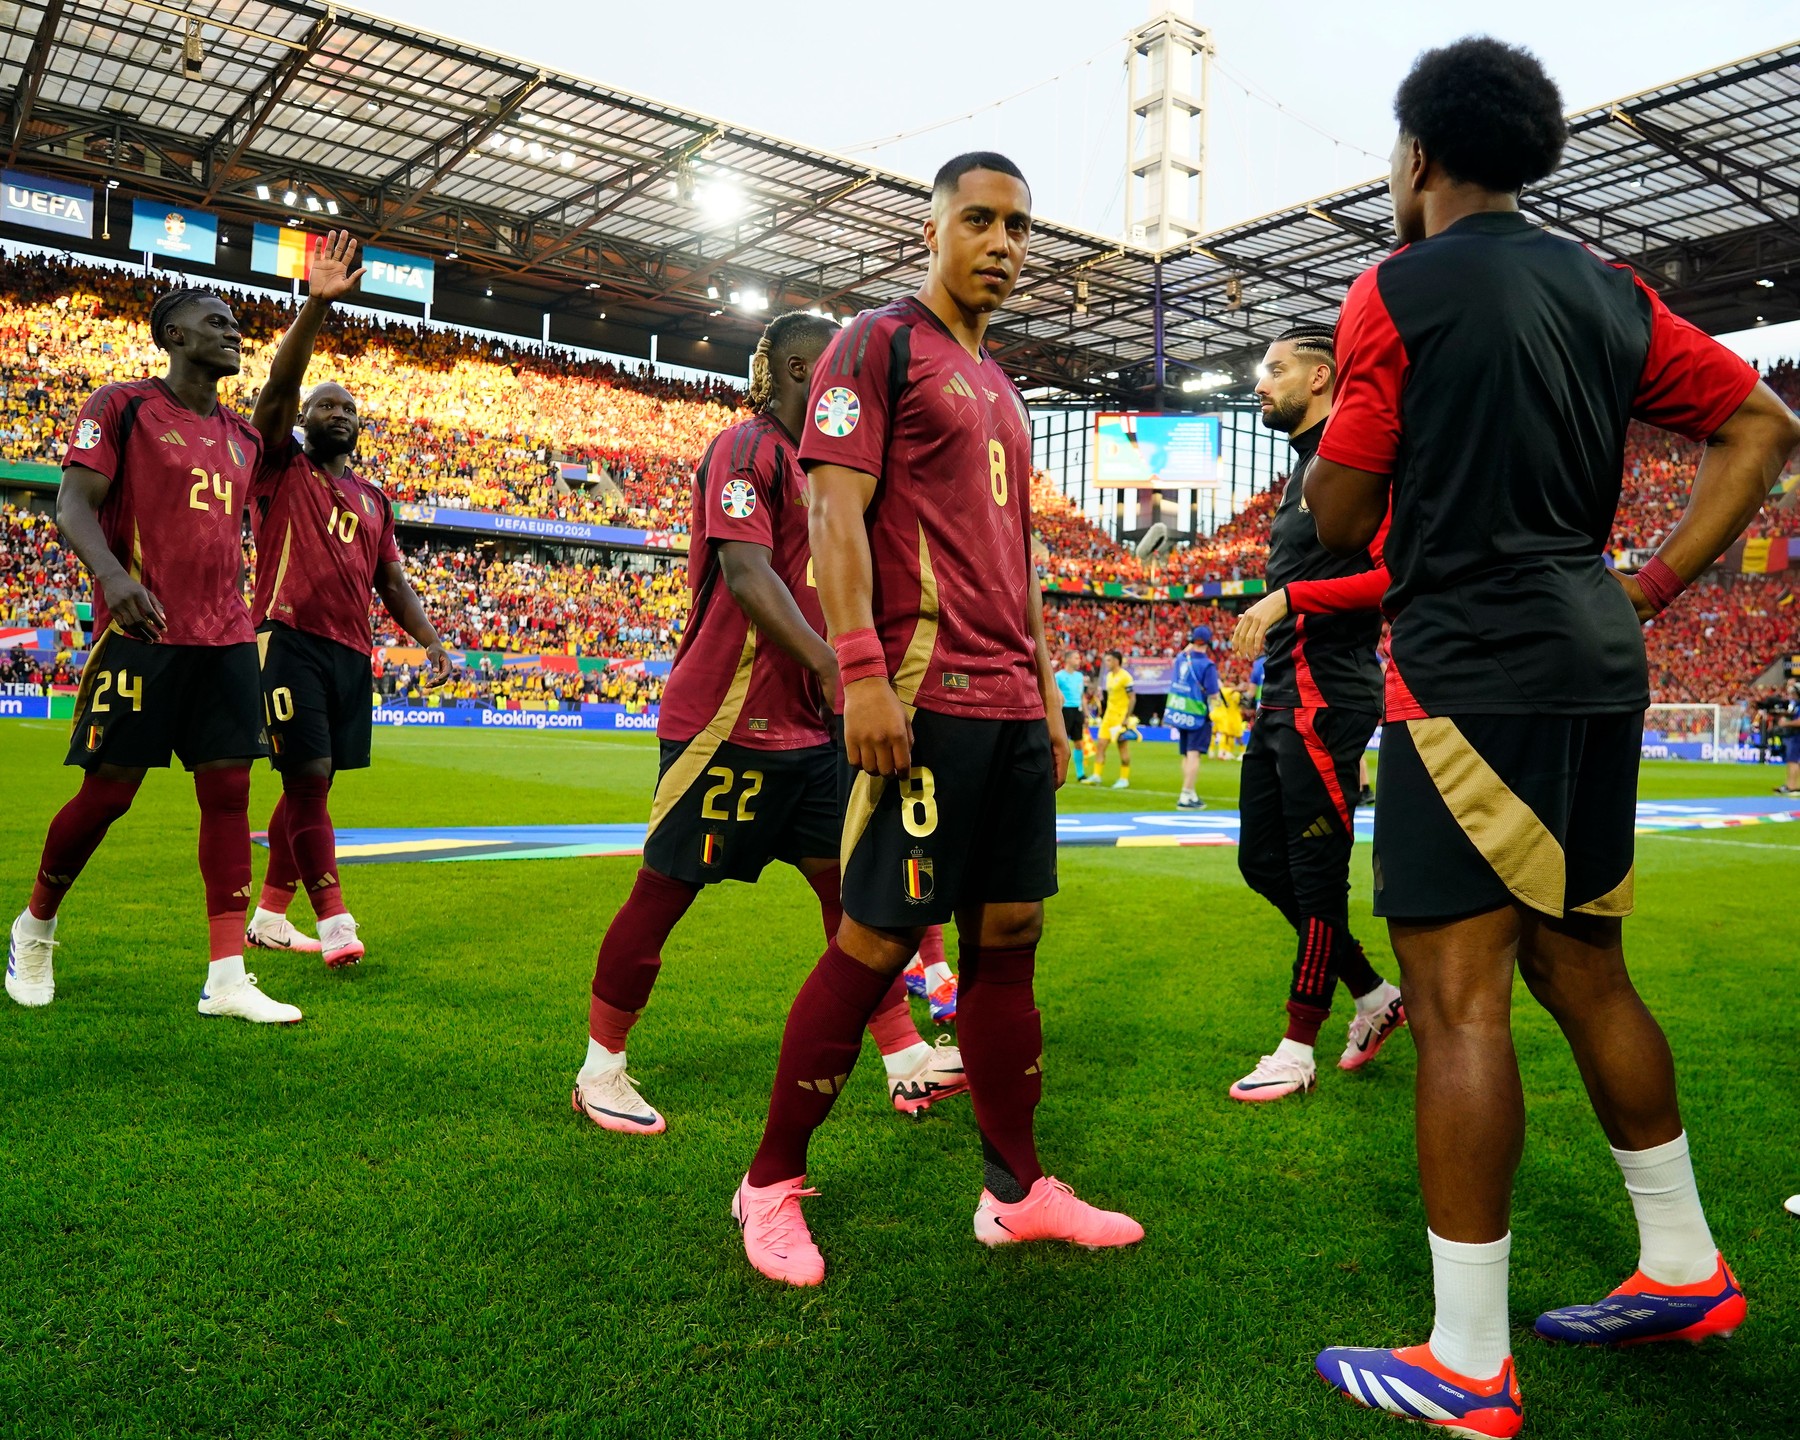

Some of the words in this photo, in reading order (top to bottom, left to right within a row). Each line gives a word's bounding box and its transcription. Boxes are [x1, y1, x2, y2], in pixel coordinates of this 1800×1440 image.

[9, 187, 84, 220] UEFA
[372, 260, 425, 289] FIFA
[189, 467, 232, 515] 24
[989, 439, 1008, 507] 8
[327, 506, 359, 543] 10
[91, 669, 142, 712] 24
[482, 709, 582, 729] Booking.com
[701, 766, 763, 821] 22
[899, 766, 938, 838] 8
